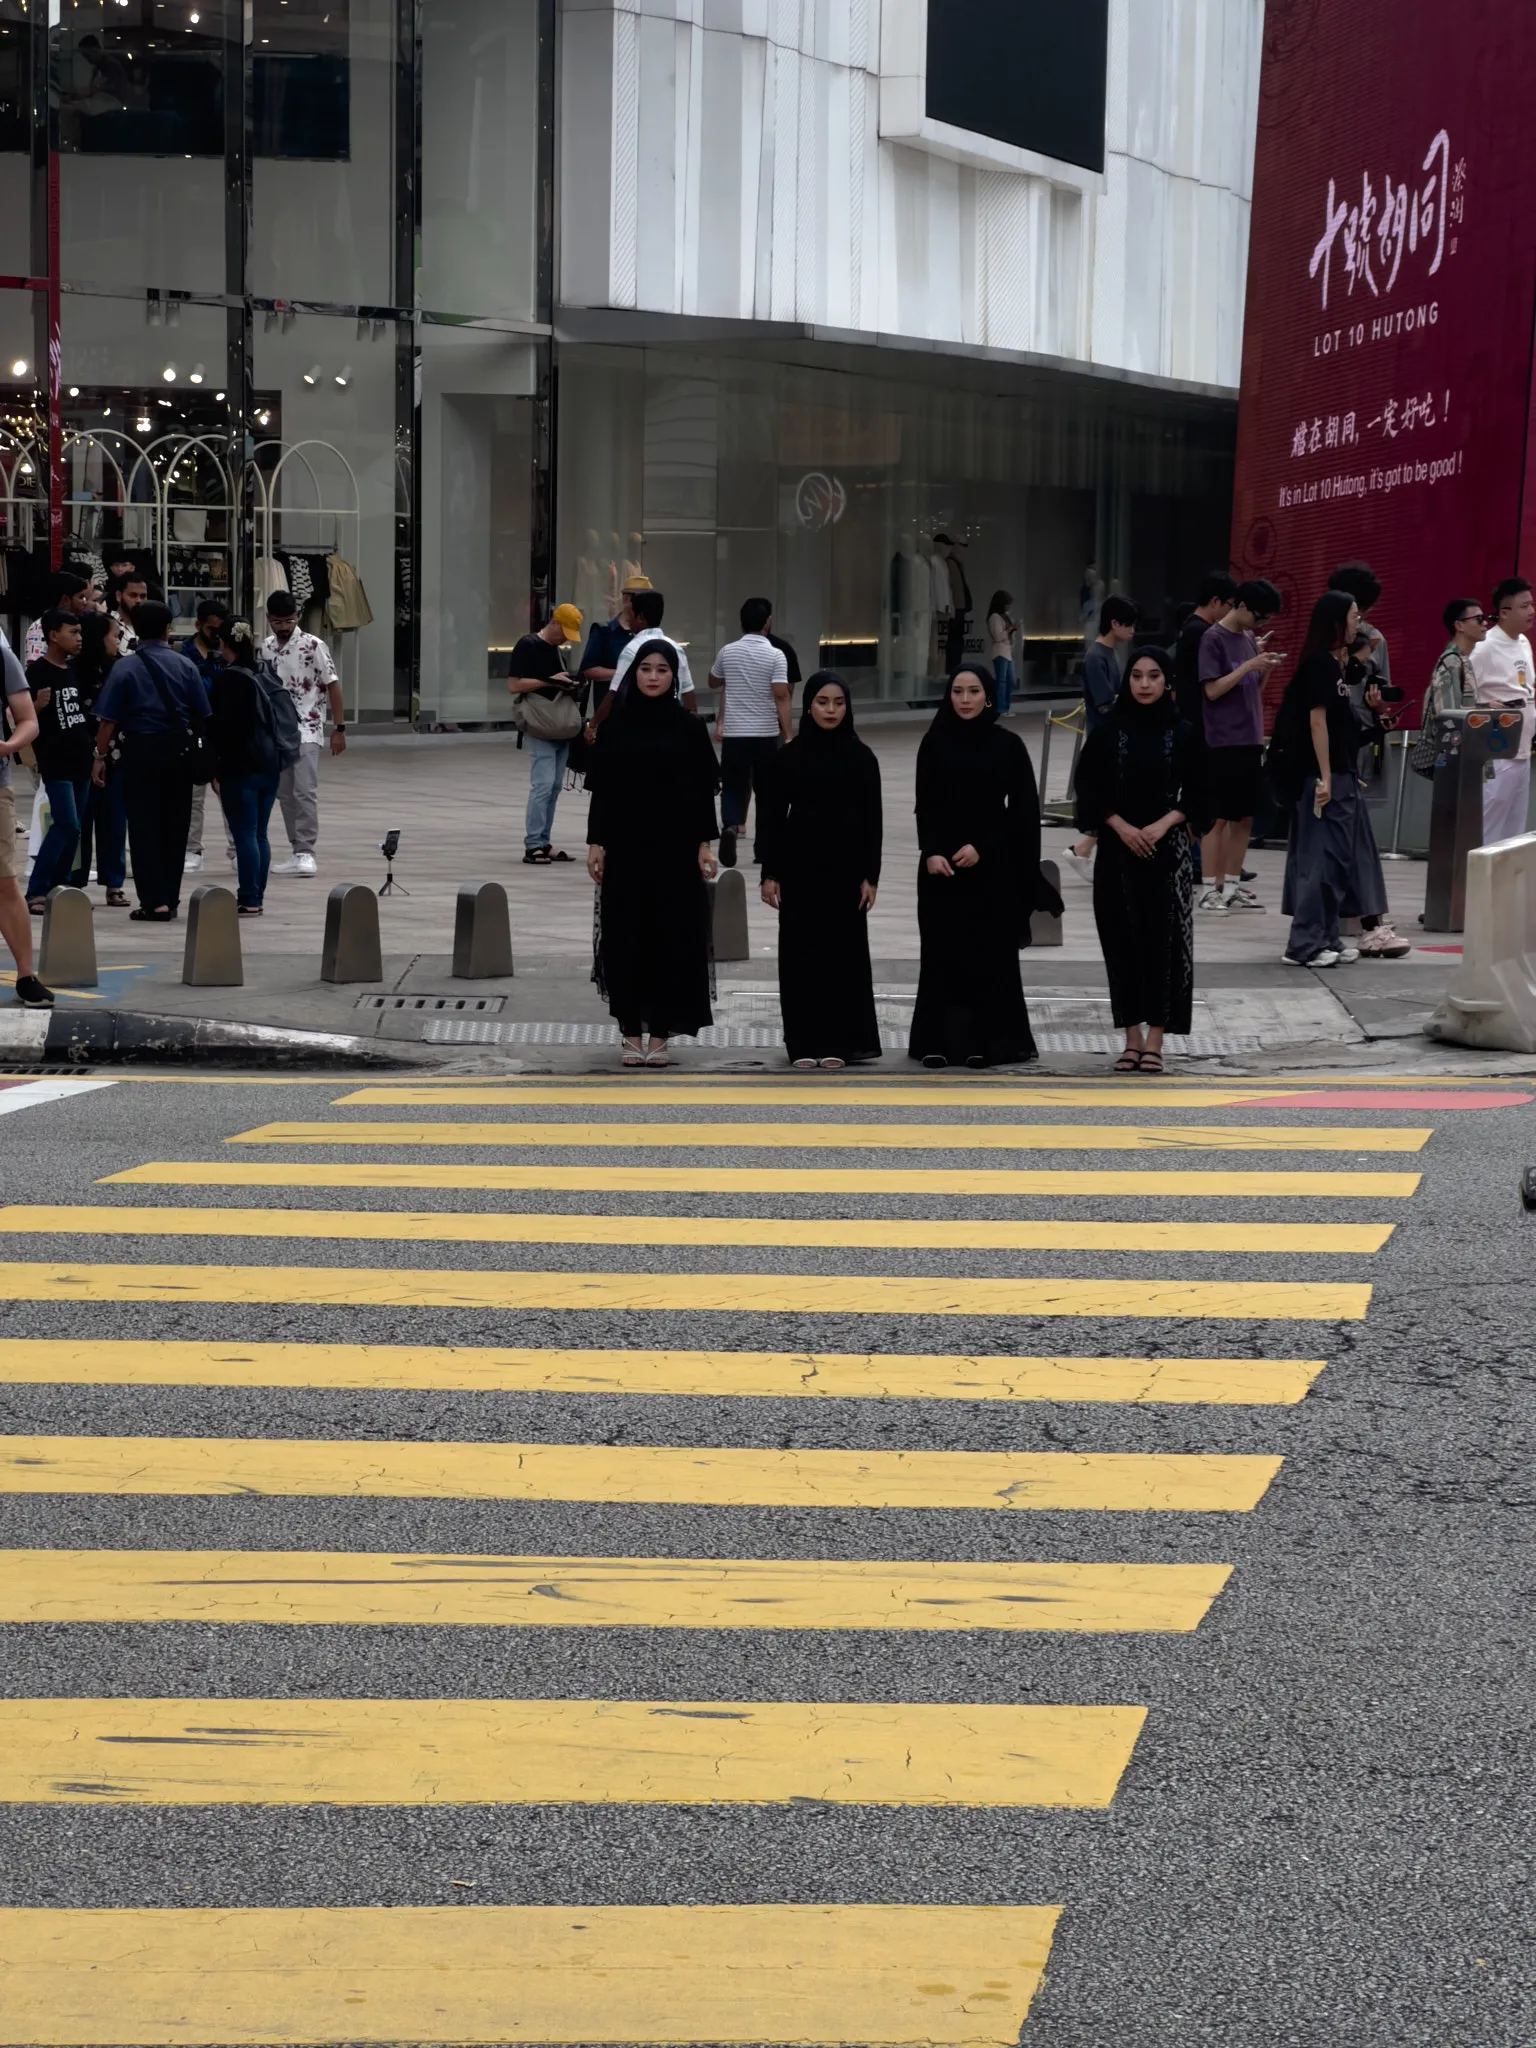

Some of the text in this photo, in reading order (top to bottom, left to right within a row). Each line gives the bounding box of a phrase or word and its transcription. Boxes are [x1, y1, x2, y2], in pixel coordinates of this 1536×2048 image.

[1314, 301, 1439, 357] LOT 10 HUTONG
[1279, 486, 1292, 507] It's
[1292, 484, 1301, 505] in
[1302, 481, 1318, 503] Lot
[1320, 478, 1331, 500] 10
[1332, 475, 1367, 498] Hutong,
[1370, 466, 1384, 490] it's
[1384, 463, 1402, 493] got
[1403, 462, 1413, 484] to
[1415, 459, 1428, 482] be
